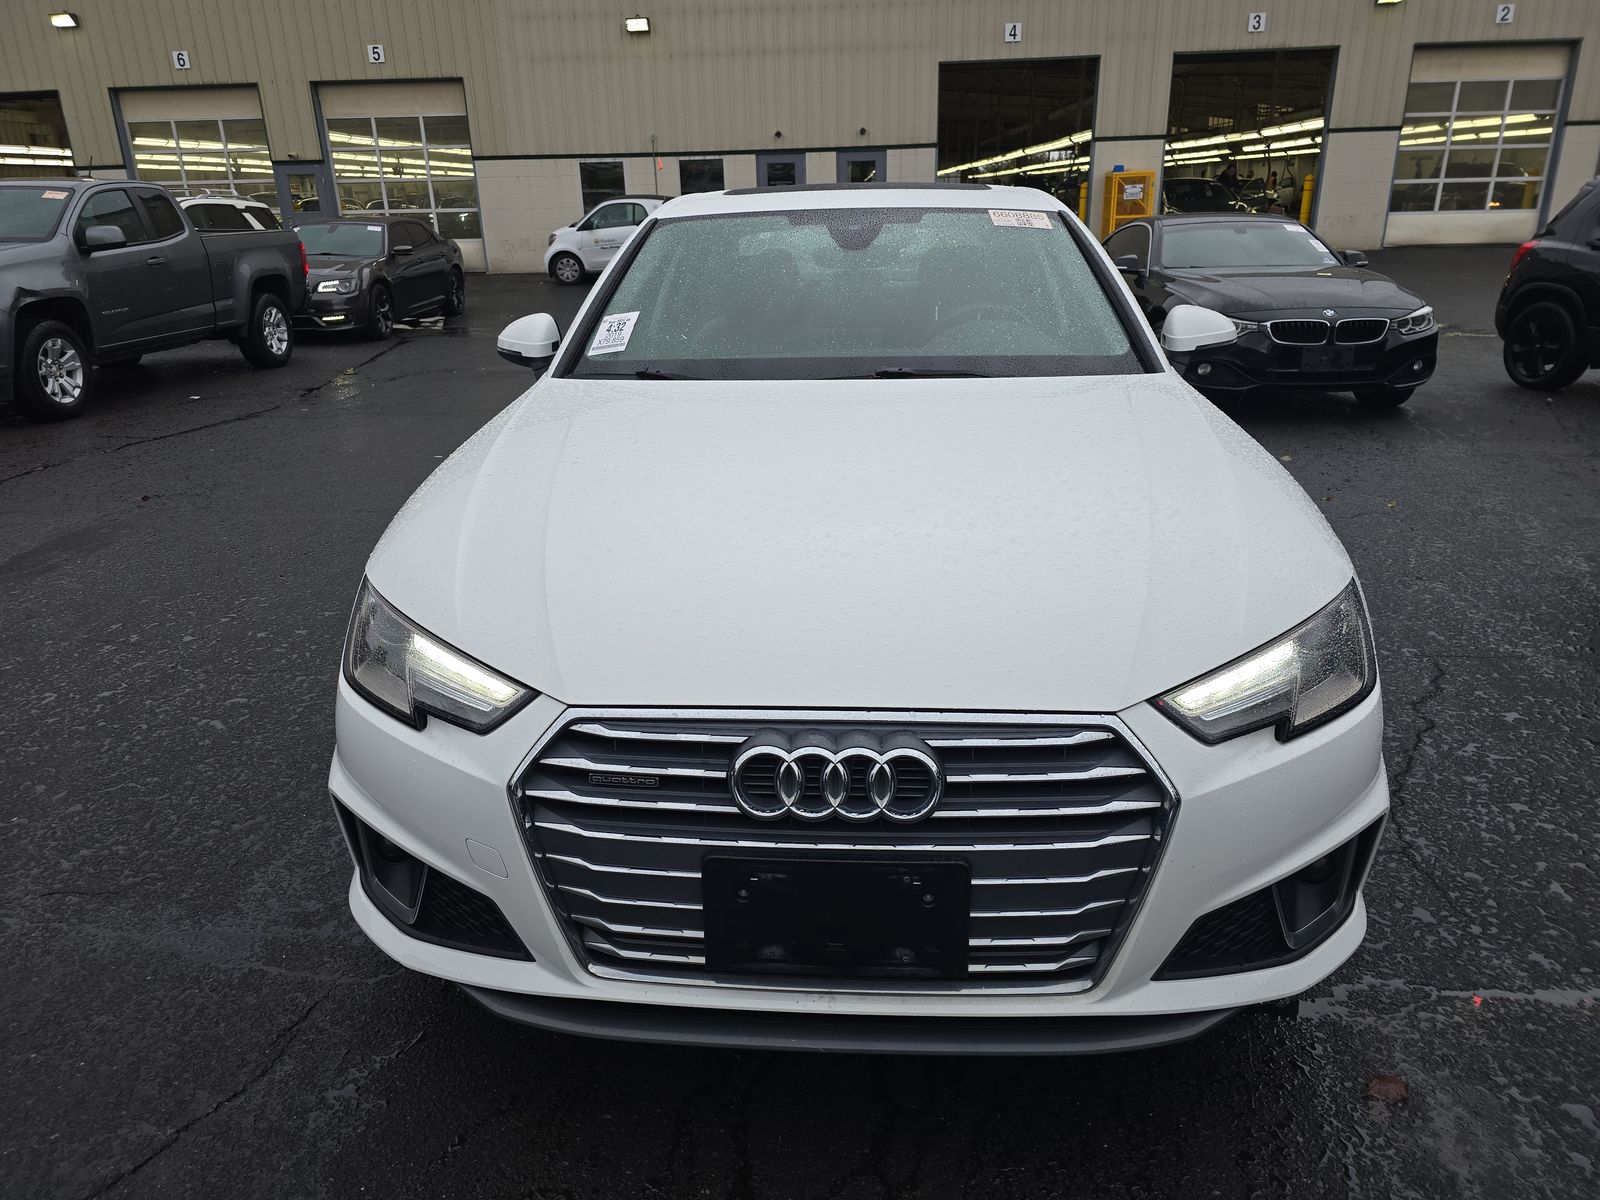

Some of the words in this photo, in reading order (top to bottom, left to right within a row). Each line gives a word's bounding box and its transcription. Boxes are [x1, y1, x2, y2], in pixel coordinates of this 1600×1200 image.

[1500, 6, 1511, 21] 2
[1252, 14, 1261, 30] 3
[1009, 24, 1018, 40] 4
[177, 52, 186, 67] 6
[372, 46, 381, 61] 5
[606, 321, 627, 333] 4:32
[592, 775, 656, 785] quattro
